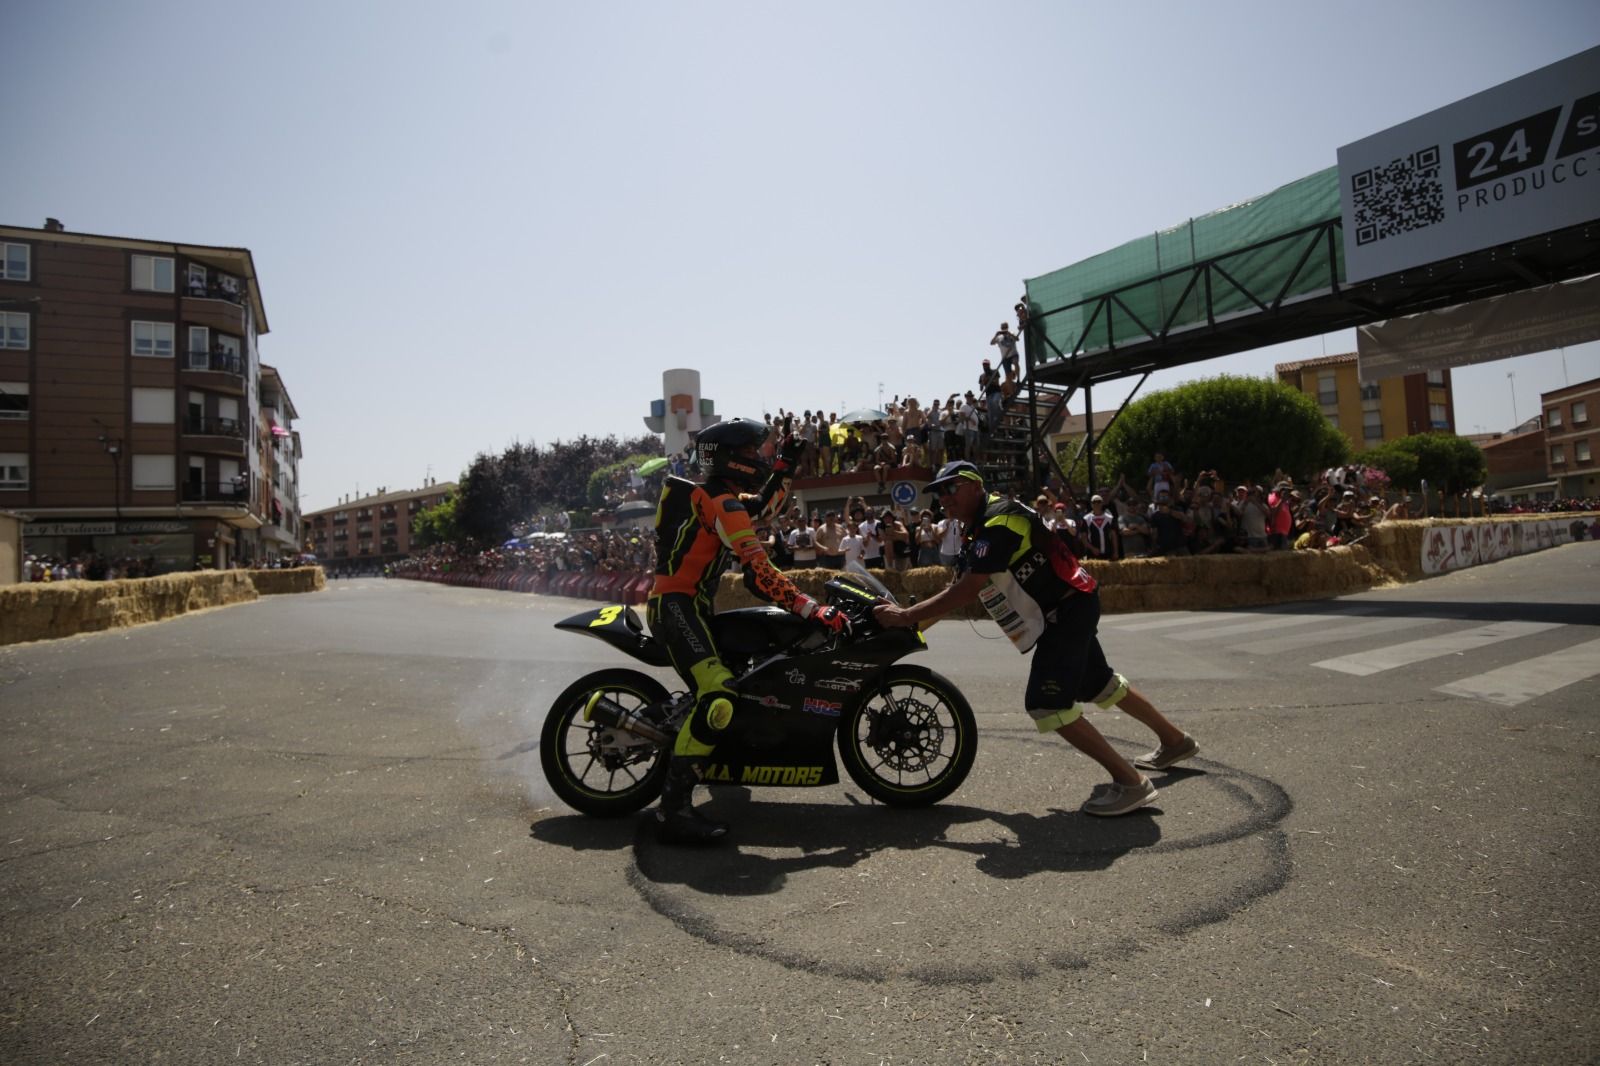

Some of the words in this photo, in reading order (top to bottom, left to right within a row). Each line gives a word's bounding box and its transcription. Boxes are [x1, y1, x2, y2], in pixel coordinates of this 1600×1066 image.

[1467, 128, 1531, 179] 24
[1577, 109, 1600, 136] s
[1457, 150, 1600, 212] PRODUCC
[589, 605, 623, 628] 3
[803, 697, 842, 717] HRC
[741, 766, 824, 785] MOTORS
